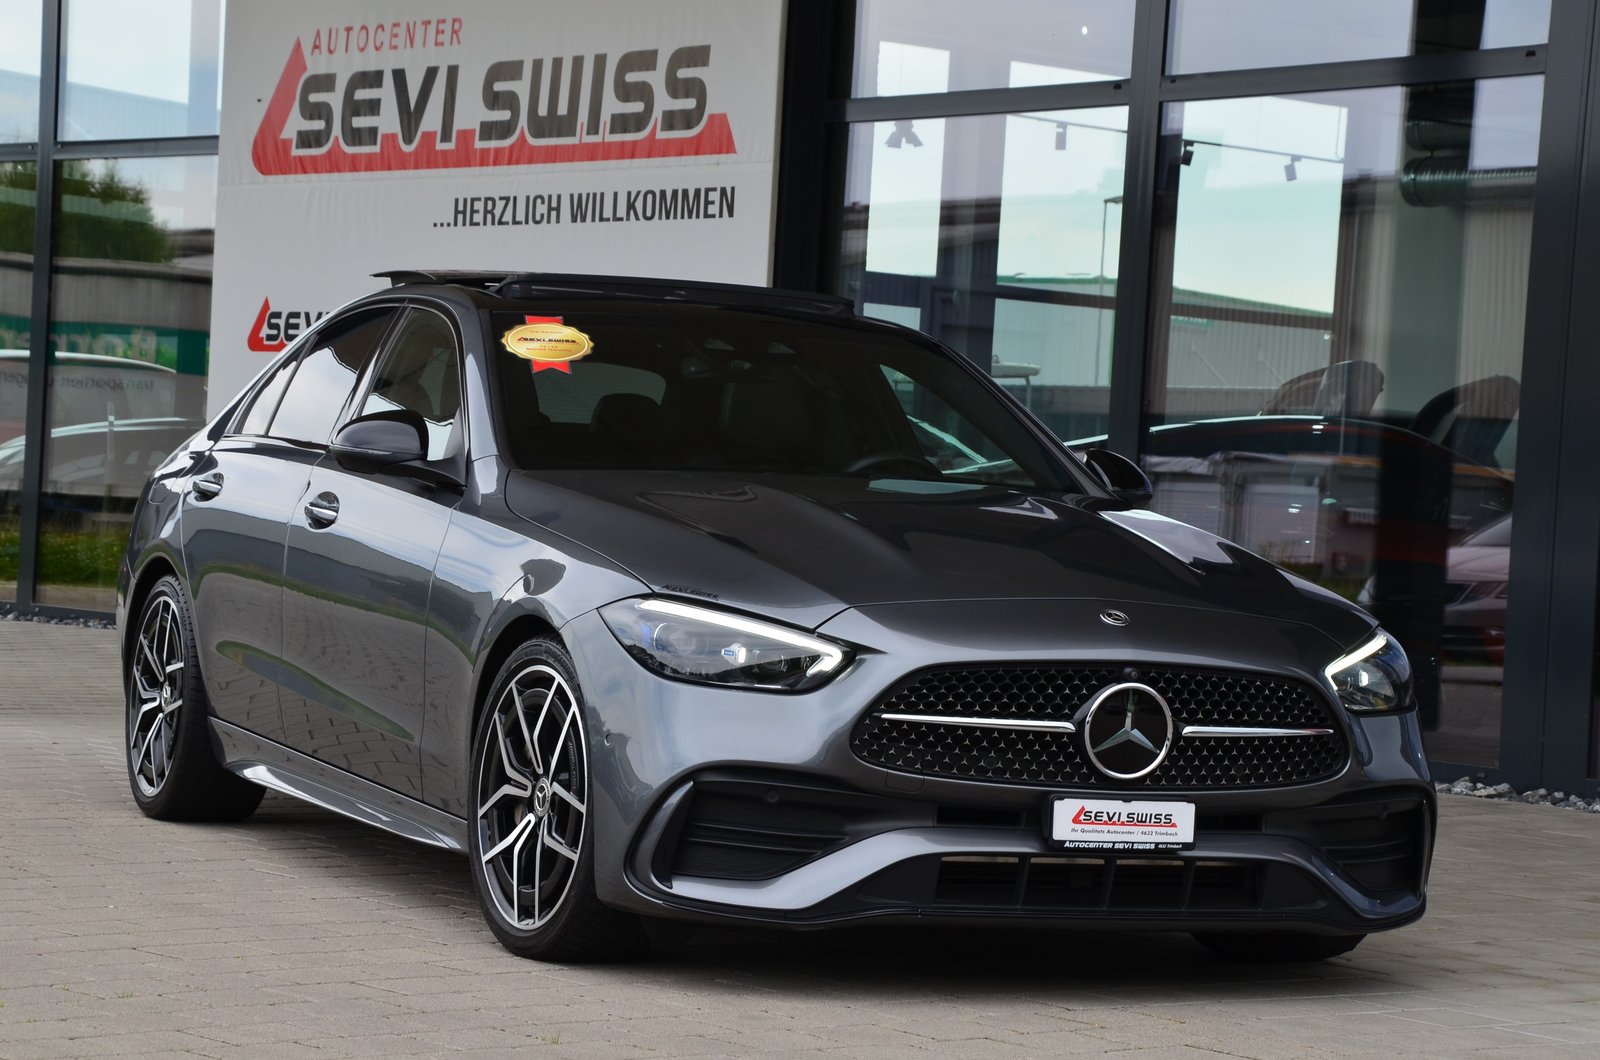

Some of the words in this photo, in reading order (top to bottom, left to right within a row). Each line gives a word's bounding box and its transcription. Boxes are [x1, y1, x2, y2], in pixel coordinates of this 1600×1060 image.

[311, 17, 463, 56] AUTOCENTER
[295, 65, 459, 151] SEVI
[478, 44, 711, 142] SWISS
[433, 194, 561, 227] ...HERZLICH
[569, 186, 735, 223] WILLKOMMEN
[1082, 811, 1121, 823] SEVI
[1126, 812, 1173, 825] SWISS
